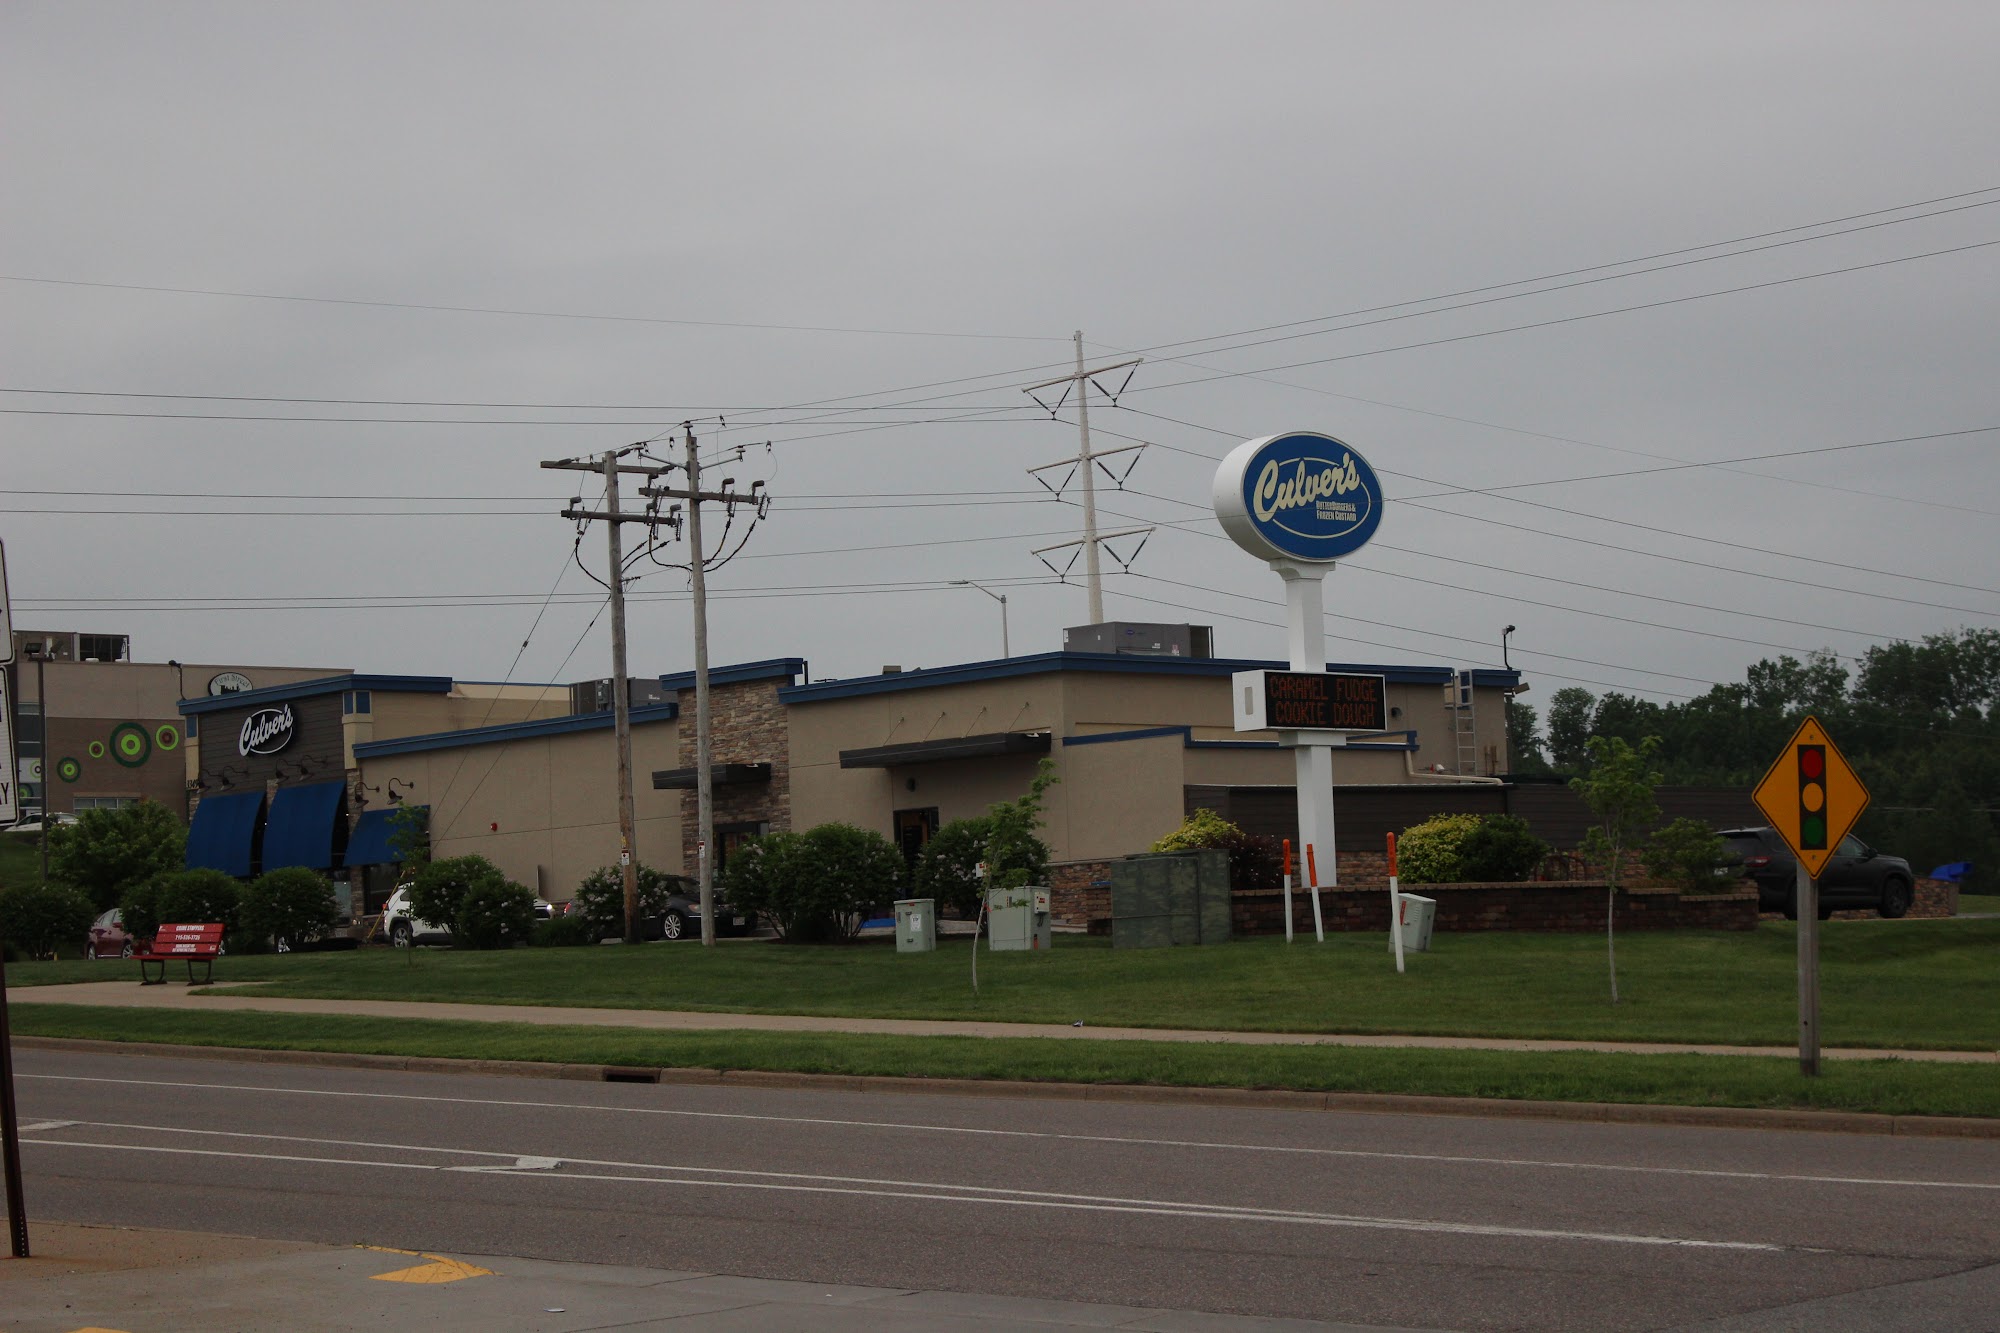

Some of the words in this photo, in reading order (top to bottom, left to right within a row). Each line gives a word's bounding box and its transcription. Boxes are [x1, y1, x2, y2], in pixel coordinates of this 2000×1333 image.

[1253, 452, 1360, 522] Culver's
[1316, 510, 1334, 520] FROZEN
[1335, 511, 1357, 522] CUSTARD
[214, 675, 230, 687] First
[231, 674, 250, 688] Street
[1270, 675, 1328, 700] CARAMEL
[1336, 678, 1377, 702] FUDGE
[1275, 701, 1327, 724] COOKIE
[1333, 702, 1375, 726] DOUGH
[239, 703, 293, 757] Culver's
